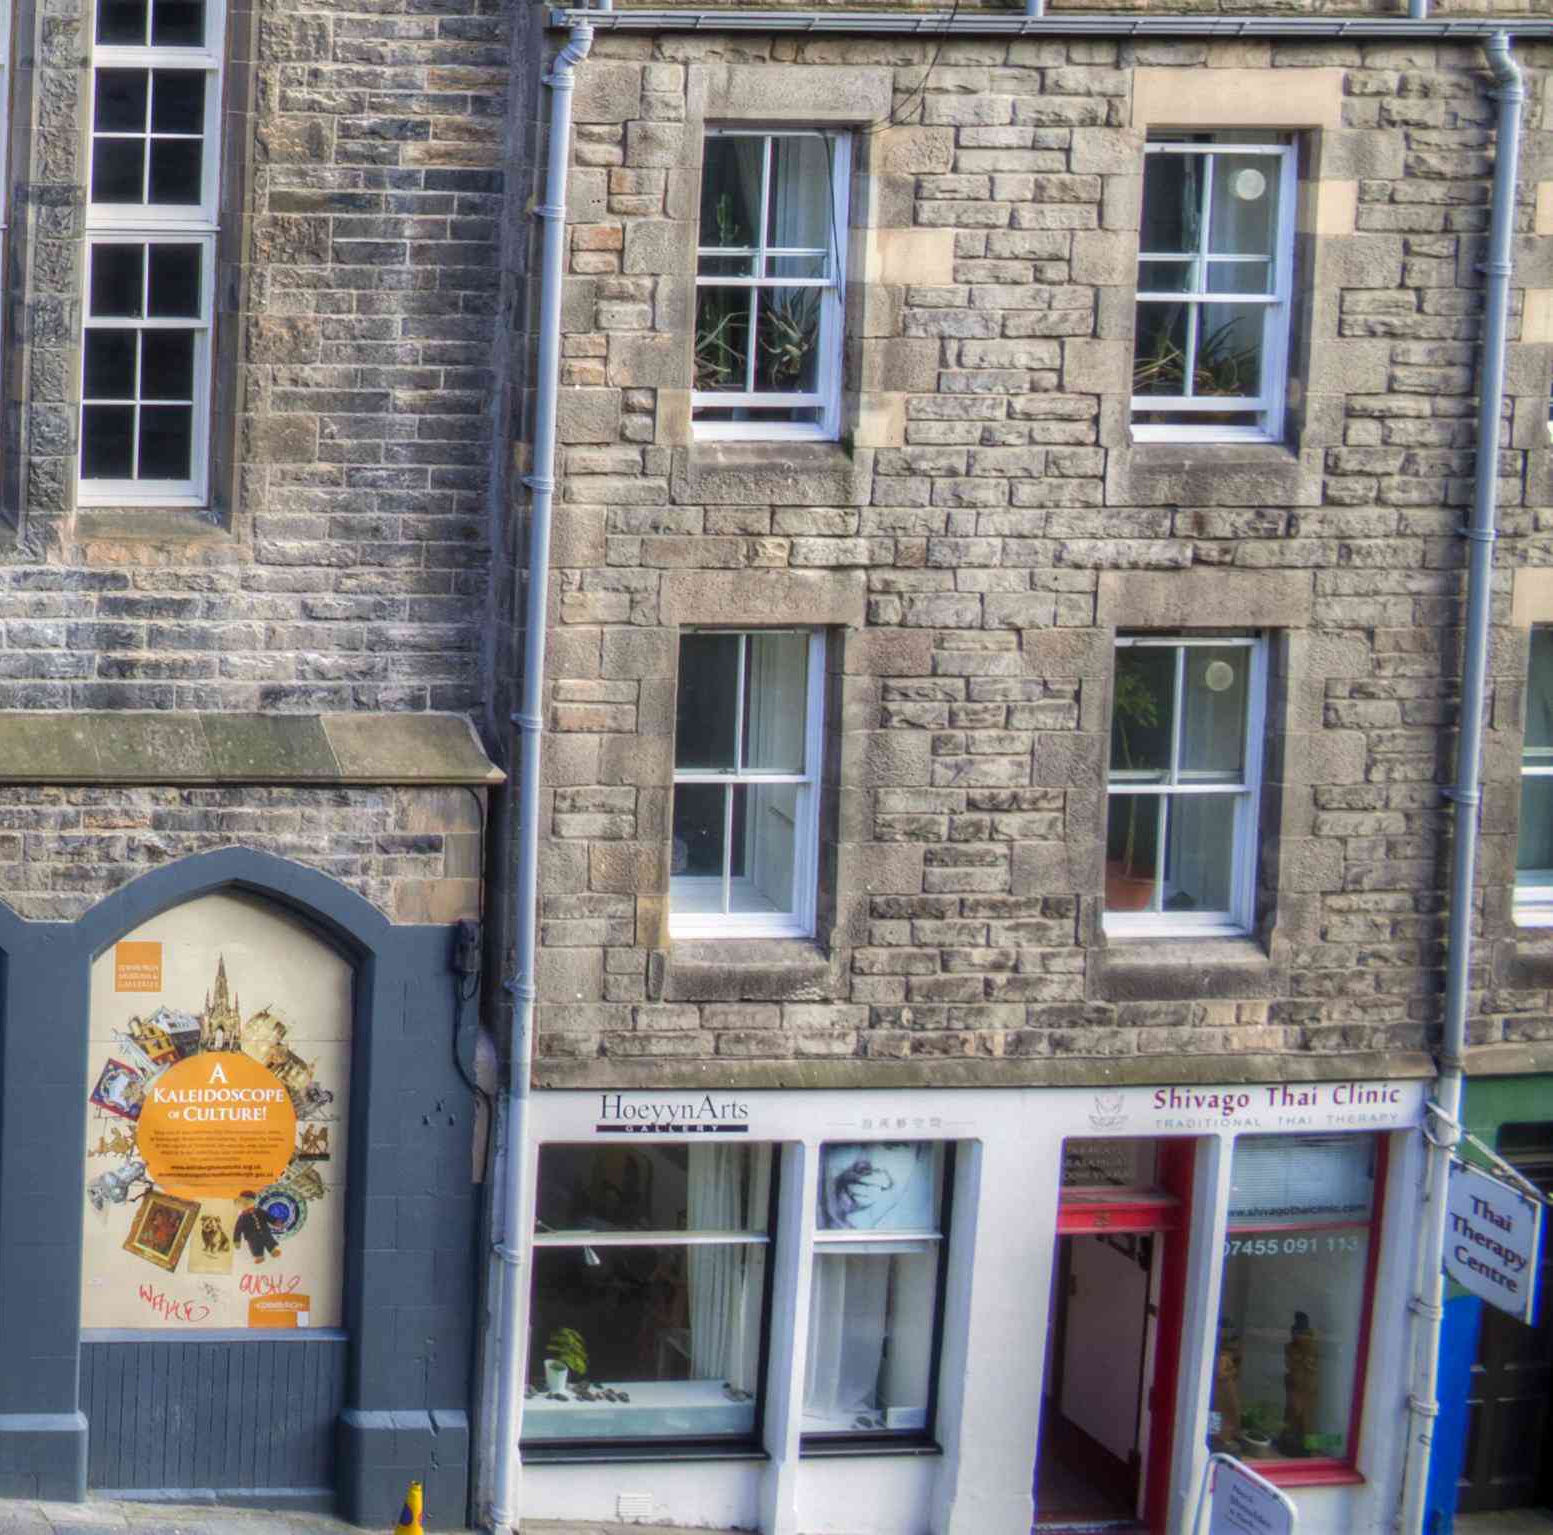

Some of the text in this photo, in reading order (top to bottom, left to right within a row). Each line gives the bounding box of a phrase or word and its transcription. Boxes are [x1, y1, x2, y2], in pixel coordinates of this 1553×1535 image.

[207, 1062, 228, 1084] A
[153, 1087, 285, 1104] KALEIDOSCOPE
[1153, 1081, 1401, 1117] Shivago Thai Clinic
[183, 1105, 267, 1121] CULTURE!
[600, 1094, 749, 1123] HoeyynArts
[1155, 1113, 1398, 1129] TRADITIONAL THAI THERAPY
[1470, 1194, 1512, 1232] Thai
[1282, 1237, 1318, 1254] 091
[1325, 1235, 1359, 1252] 113
[1450, 1212, 1527, 1272] Therapy
[1454, 1245, 1518, 1293] Centre
